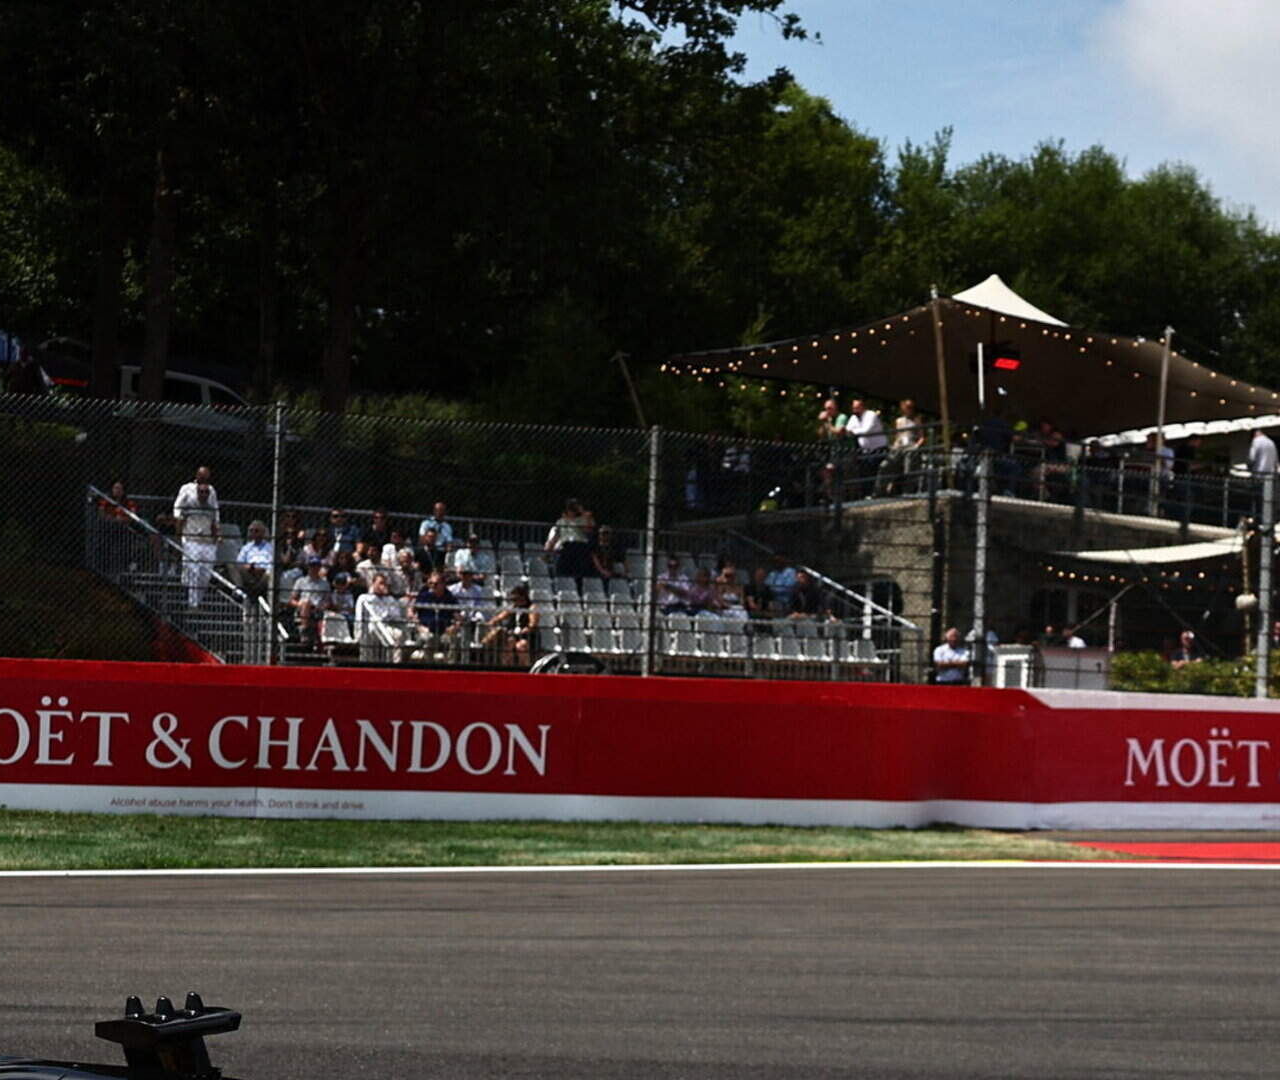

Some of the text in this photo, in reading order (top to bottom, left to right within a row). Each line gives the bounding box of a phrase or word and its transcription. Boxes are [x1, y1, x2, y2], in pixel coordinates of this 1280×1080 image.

[145, 713, 191, 769] &
[208, 715, 551, 776] CHANDON
[1124, 728, 1269, 787] MOËT
